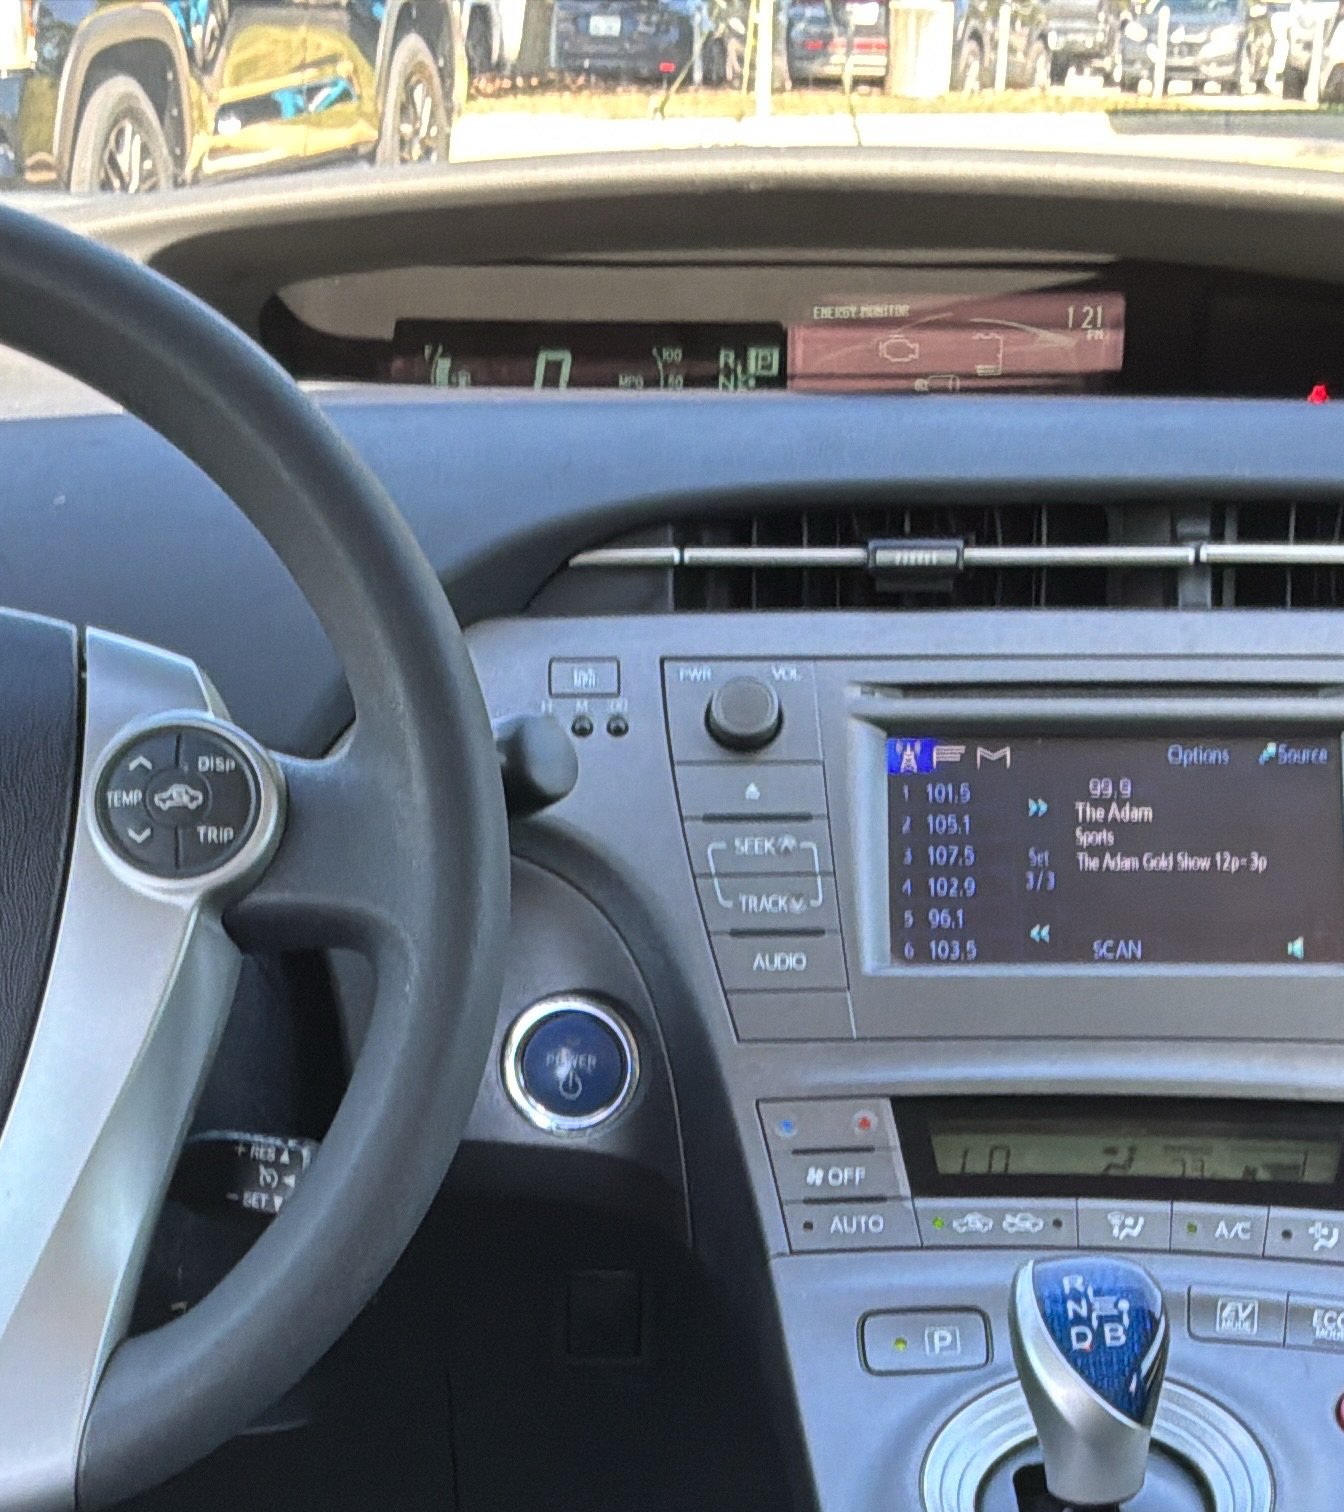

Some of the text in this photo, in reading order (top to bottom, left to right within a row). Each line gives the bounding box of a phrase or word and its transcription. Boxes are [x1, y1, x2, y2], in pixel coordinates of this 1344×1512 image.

[679, 669, 712, 682] PWR
[772, 665, 802, 681] VOL
[197, 756, 236, 773] DISP
[1167, 744, 1230, 767] Options
[1277, 744, 1328, 765] Source
[926, 782, 971, 804] 101.5
[1089, 777, 1132, 798] 99.9
[106, 789, 143, 808] TEMP
[1075, 801, 1153, 823] The Adam
[197, 826, 234, 844] TRIP
[927, 814, 971, 835] 105.1
[734, 838, 776, 855] SEEK
[1075, 827, 1114, 849] Sports
[927, 845, 976, 866] 107.5
[1076, 852, 1099, 871] The
[1102, 853, 1139, 872] Adam
[1143, 852, 1173, 872] Gold
[1177, 851, 1211, 872] Show
[928, 877, 976, 898] 102.9
[739, 894, 787, 913] TRACK
[928, 908, 965, 929] 96.1
[929, 940, 977, 960] 103.5
[1093, 939, 1142, 960] SCAN
[753, 953, 807, 971] AUDIO
[828, 1167, 866, 1187] OFF
[830, 1214, 884, 1234] AUTO
[1214, 1220, 1251, 1241] A/C
[1062, 1274, 1084, 1295] R
[1067, 1298, 1088, 1320] N
[1222, 1301, 1255, 1320] EV
[1070, 1322, 1126, 1351] D B
